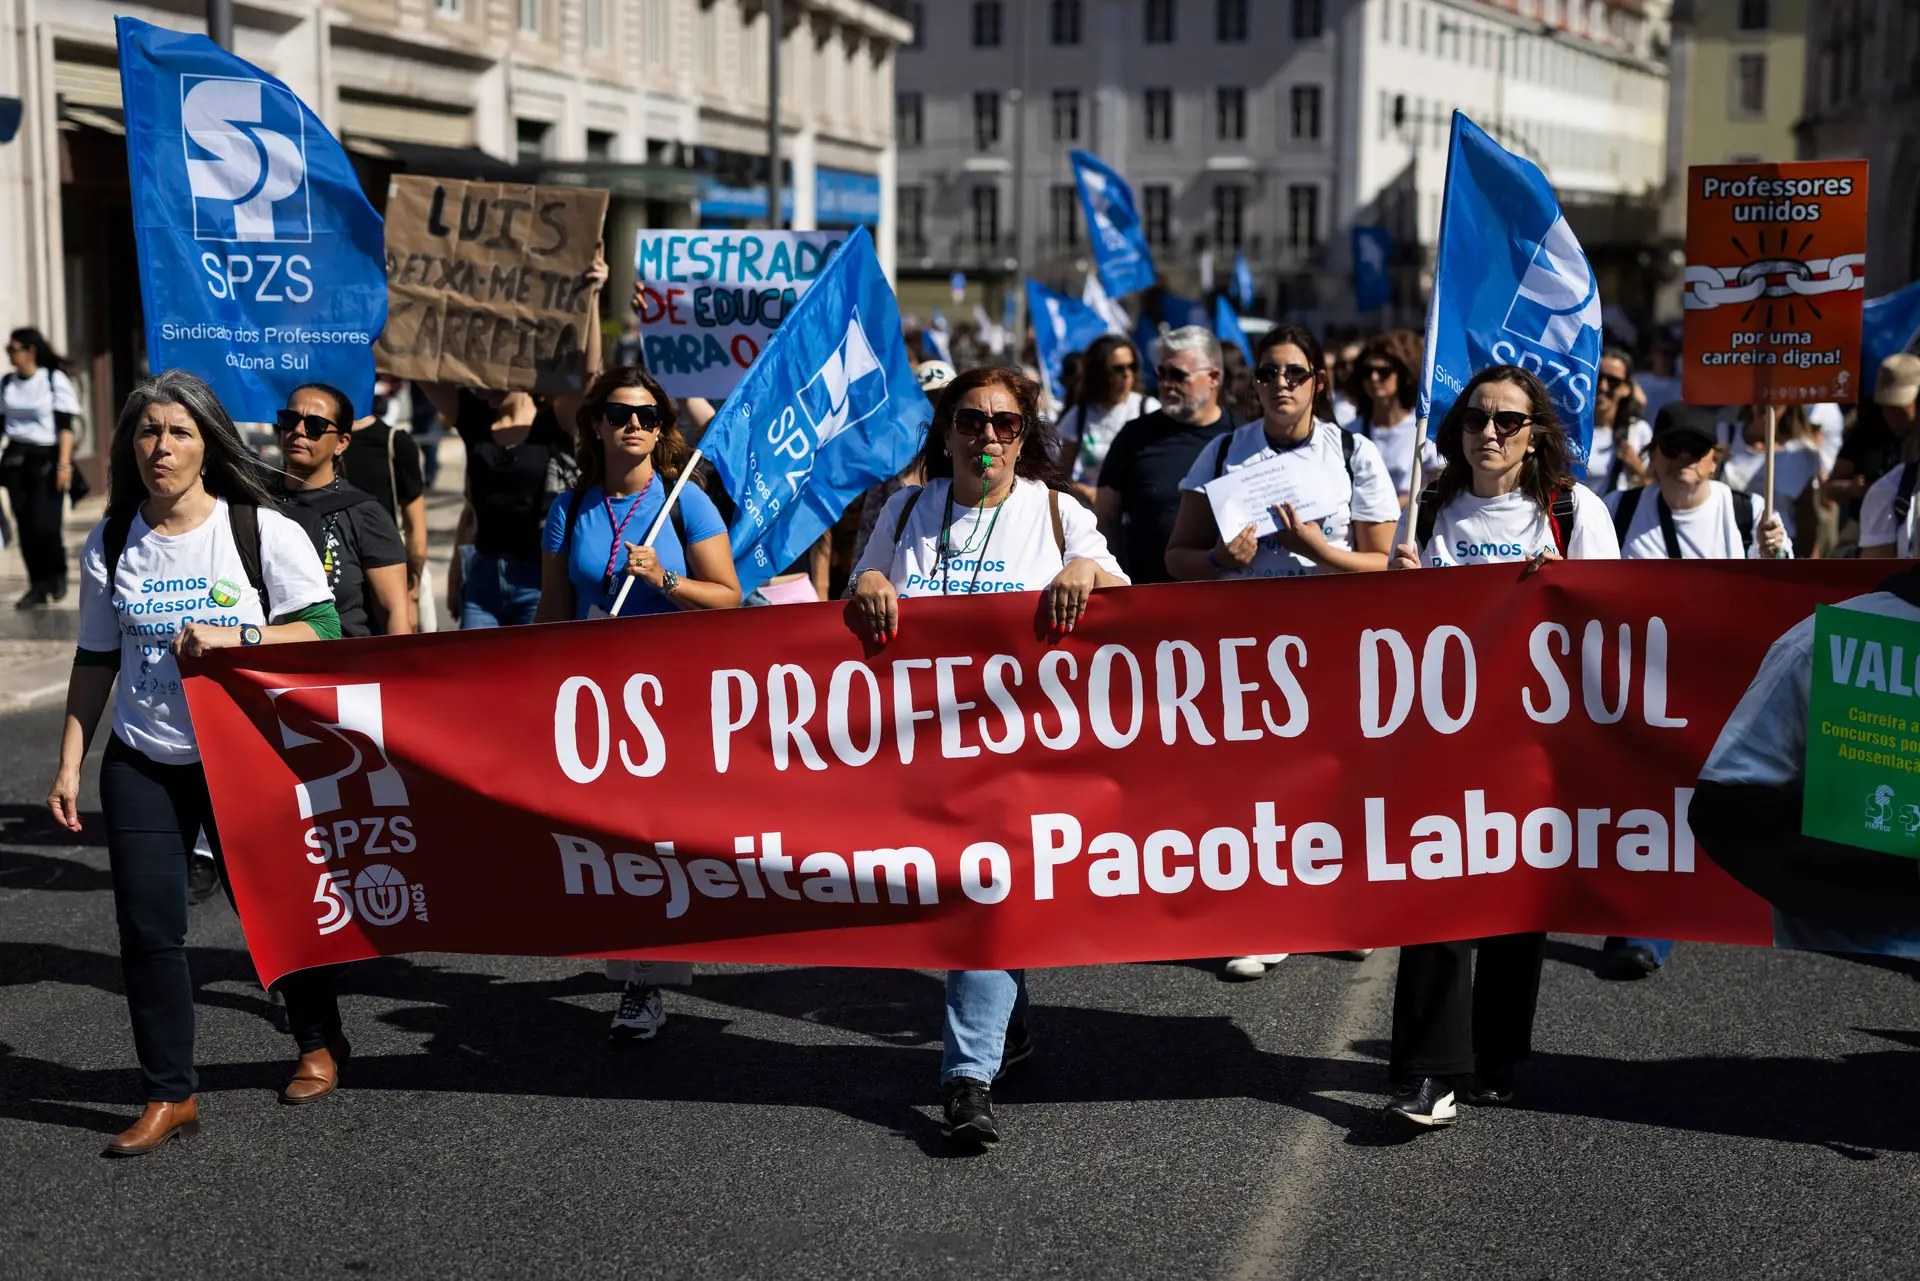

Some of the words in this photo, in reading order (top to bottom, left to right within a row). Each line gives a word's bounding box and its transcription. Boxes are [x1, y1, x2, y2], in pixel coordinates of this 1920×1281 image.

[1703, 176, 1852, 198] Professores
[428, 184, 569, 256] LUIS
[1734, 200, 1820, 222] unidos
[201, 252, 314, 303] SPZS
[640, 287, 688, 326] DE
[235, 326, 260, 343] dos
[264, 327, 370, 344] Professores
[1731, 332, 1764, 349] por
[1769, 332, 1812, 345] uma
[238, 353, 275, 370] Zona
[280, 353, 310, 370] Sul
[644, 332, 731, 376] PARA
[730, 334, 760, 370] O
[1701, 350, 1777, 366] carreira
[1782, 348, 1841, 369] digna!
[754, 471, 772, 500] dos
[1456, 540, 1522, 558] Somos
[938, 558, 1006, 572] Somos
[141, 577, 207, 594] Somos
[117, 596, 217, 616] Professore
[1829, 633, 1920, 698] VAL
[554, 672, 667, 784] OS
[710, 634, 1310, 774] PROFESSORES
[1359, 624, 1478, 739] DO
[1521, 616, 1689, 728] SUL
[1848, 706, 1907, 732] Carreira
[1821, 720, 1897, 748] Concursos
[304, 815, 417, 864] SPZS
[550, 831, 940, 919] Rejeitam
[959, 841, 1011, 905] o
[1030, 800, 1344, 901] Pacote
[1364, 786, 1696, 883] Laboral
[313, 863, 410, 936] 50
[410, 883, 429, 923] ANOS
